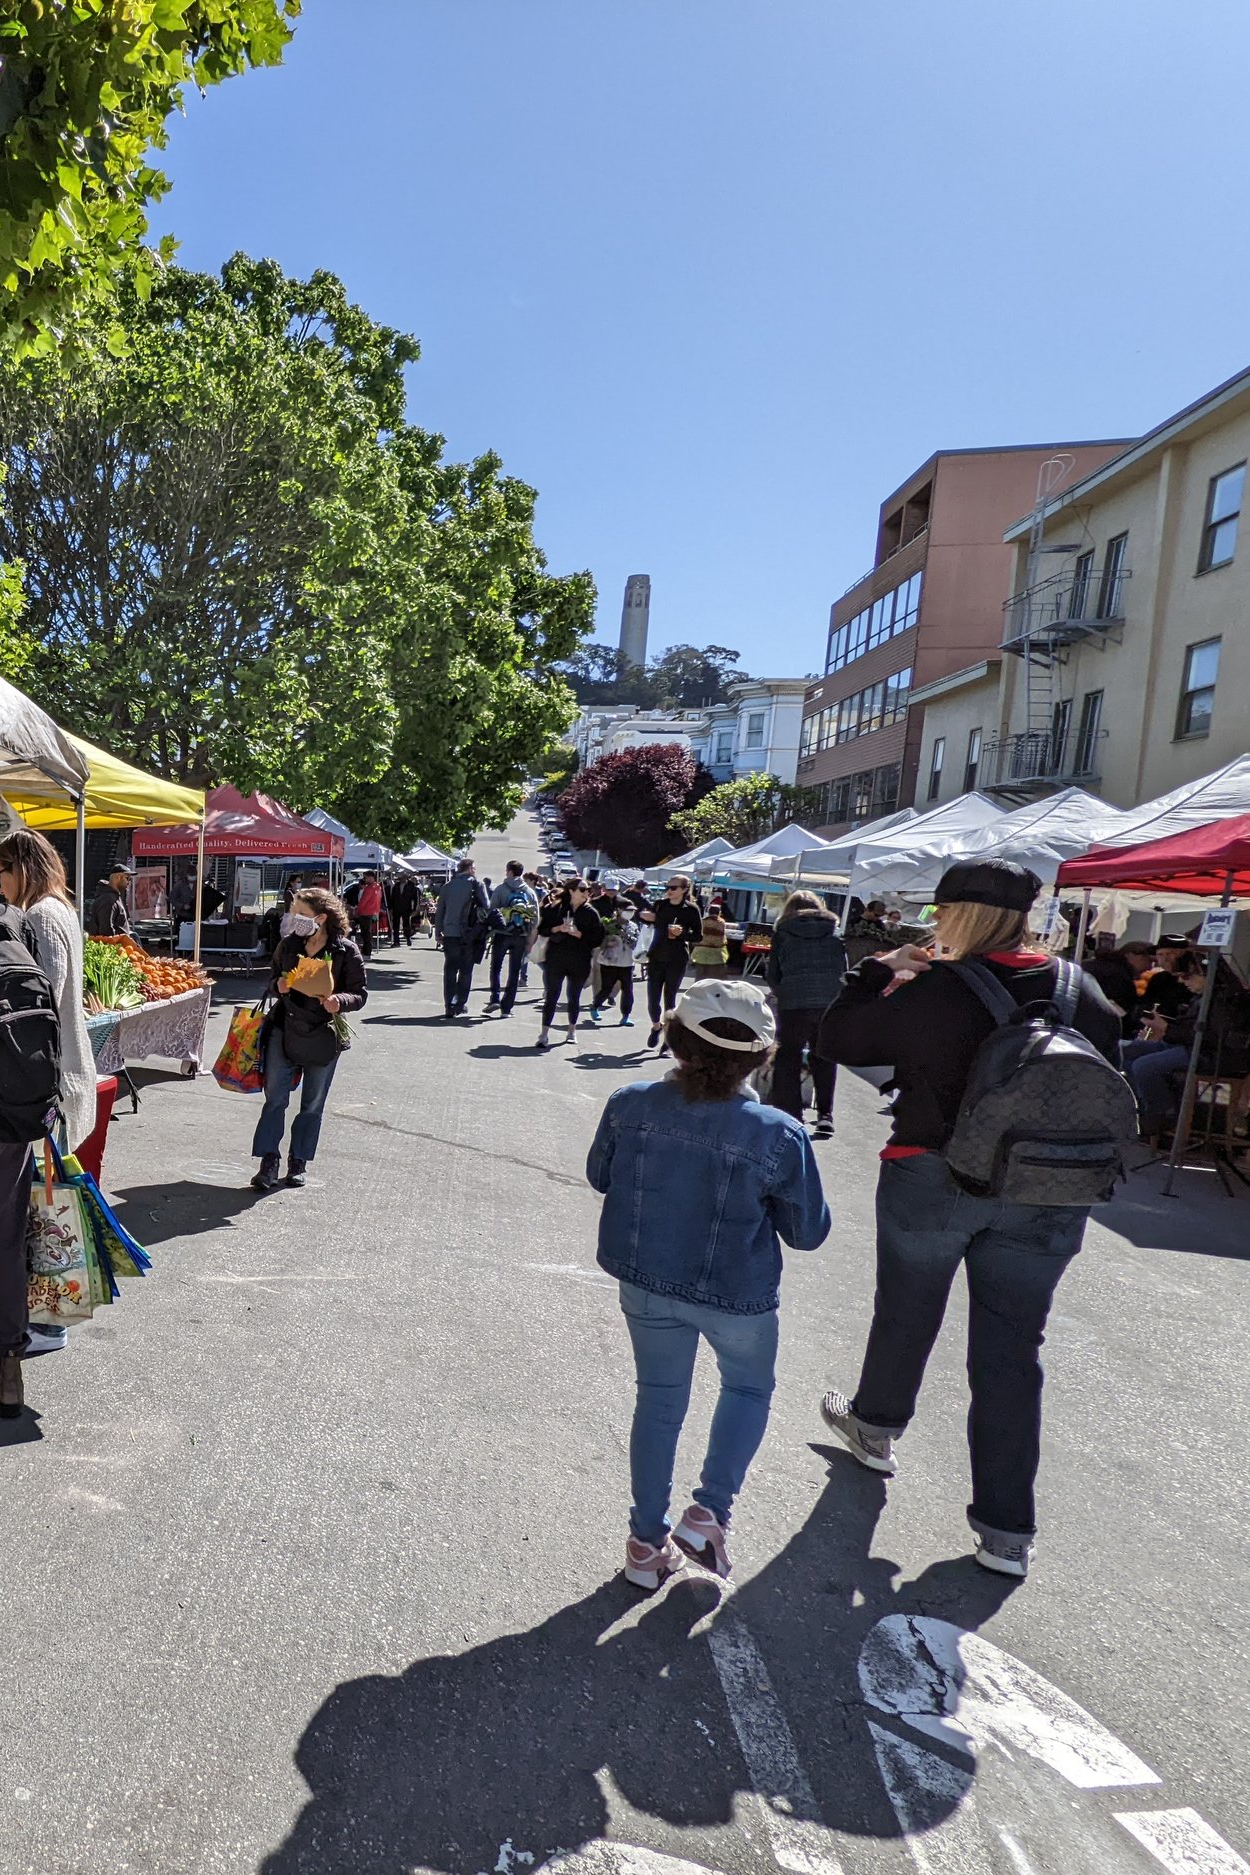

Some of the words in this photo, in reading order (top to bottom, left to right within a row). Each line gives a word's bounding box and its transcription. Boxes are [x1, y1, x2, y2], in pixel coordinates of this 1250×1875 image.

[139, 841, 194, 850] Handcrafted
[196, 838, 232, 848] uality,
[235, 838, 279, 848] Delivered
